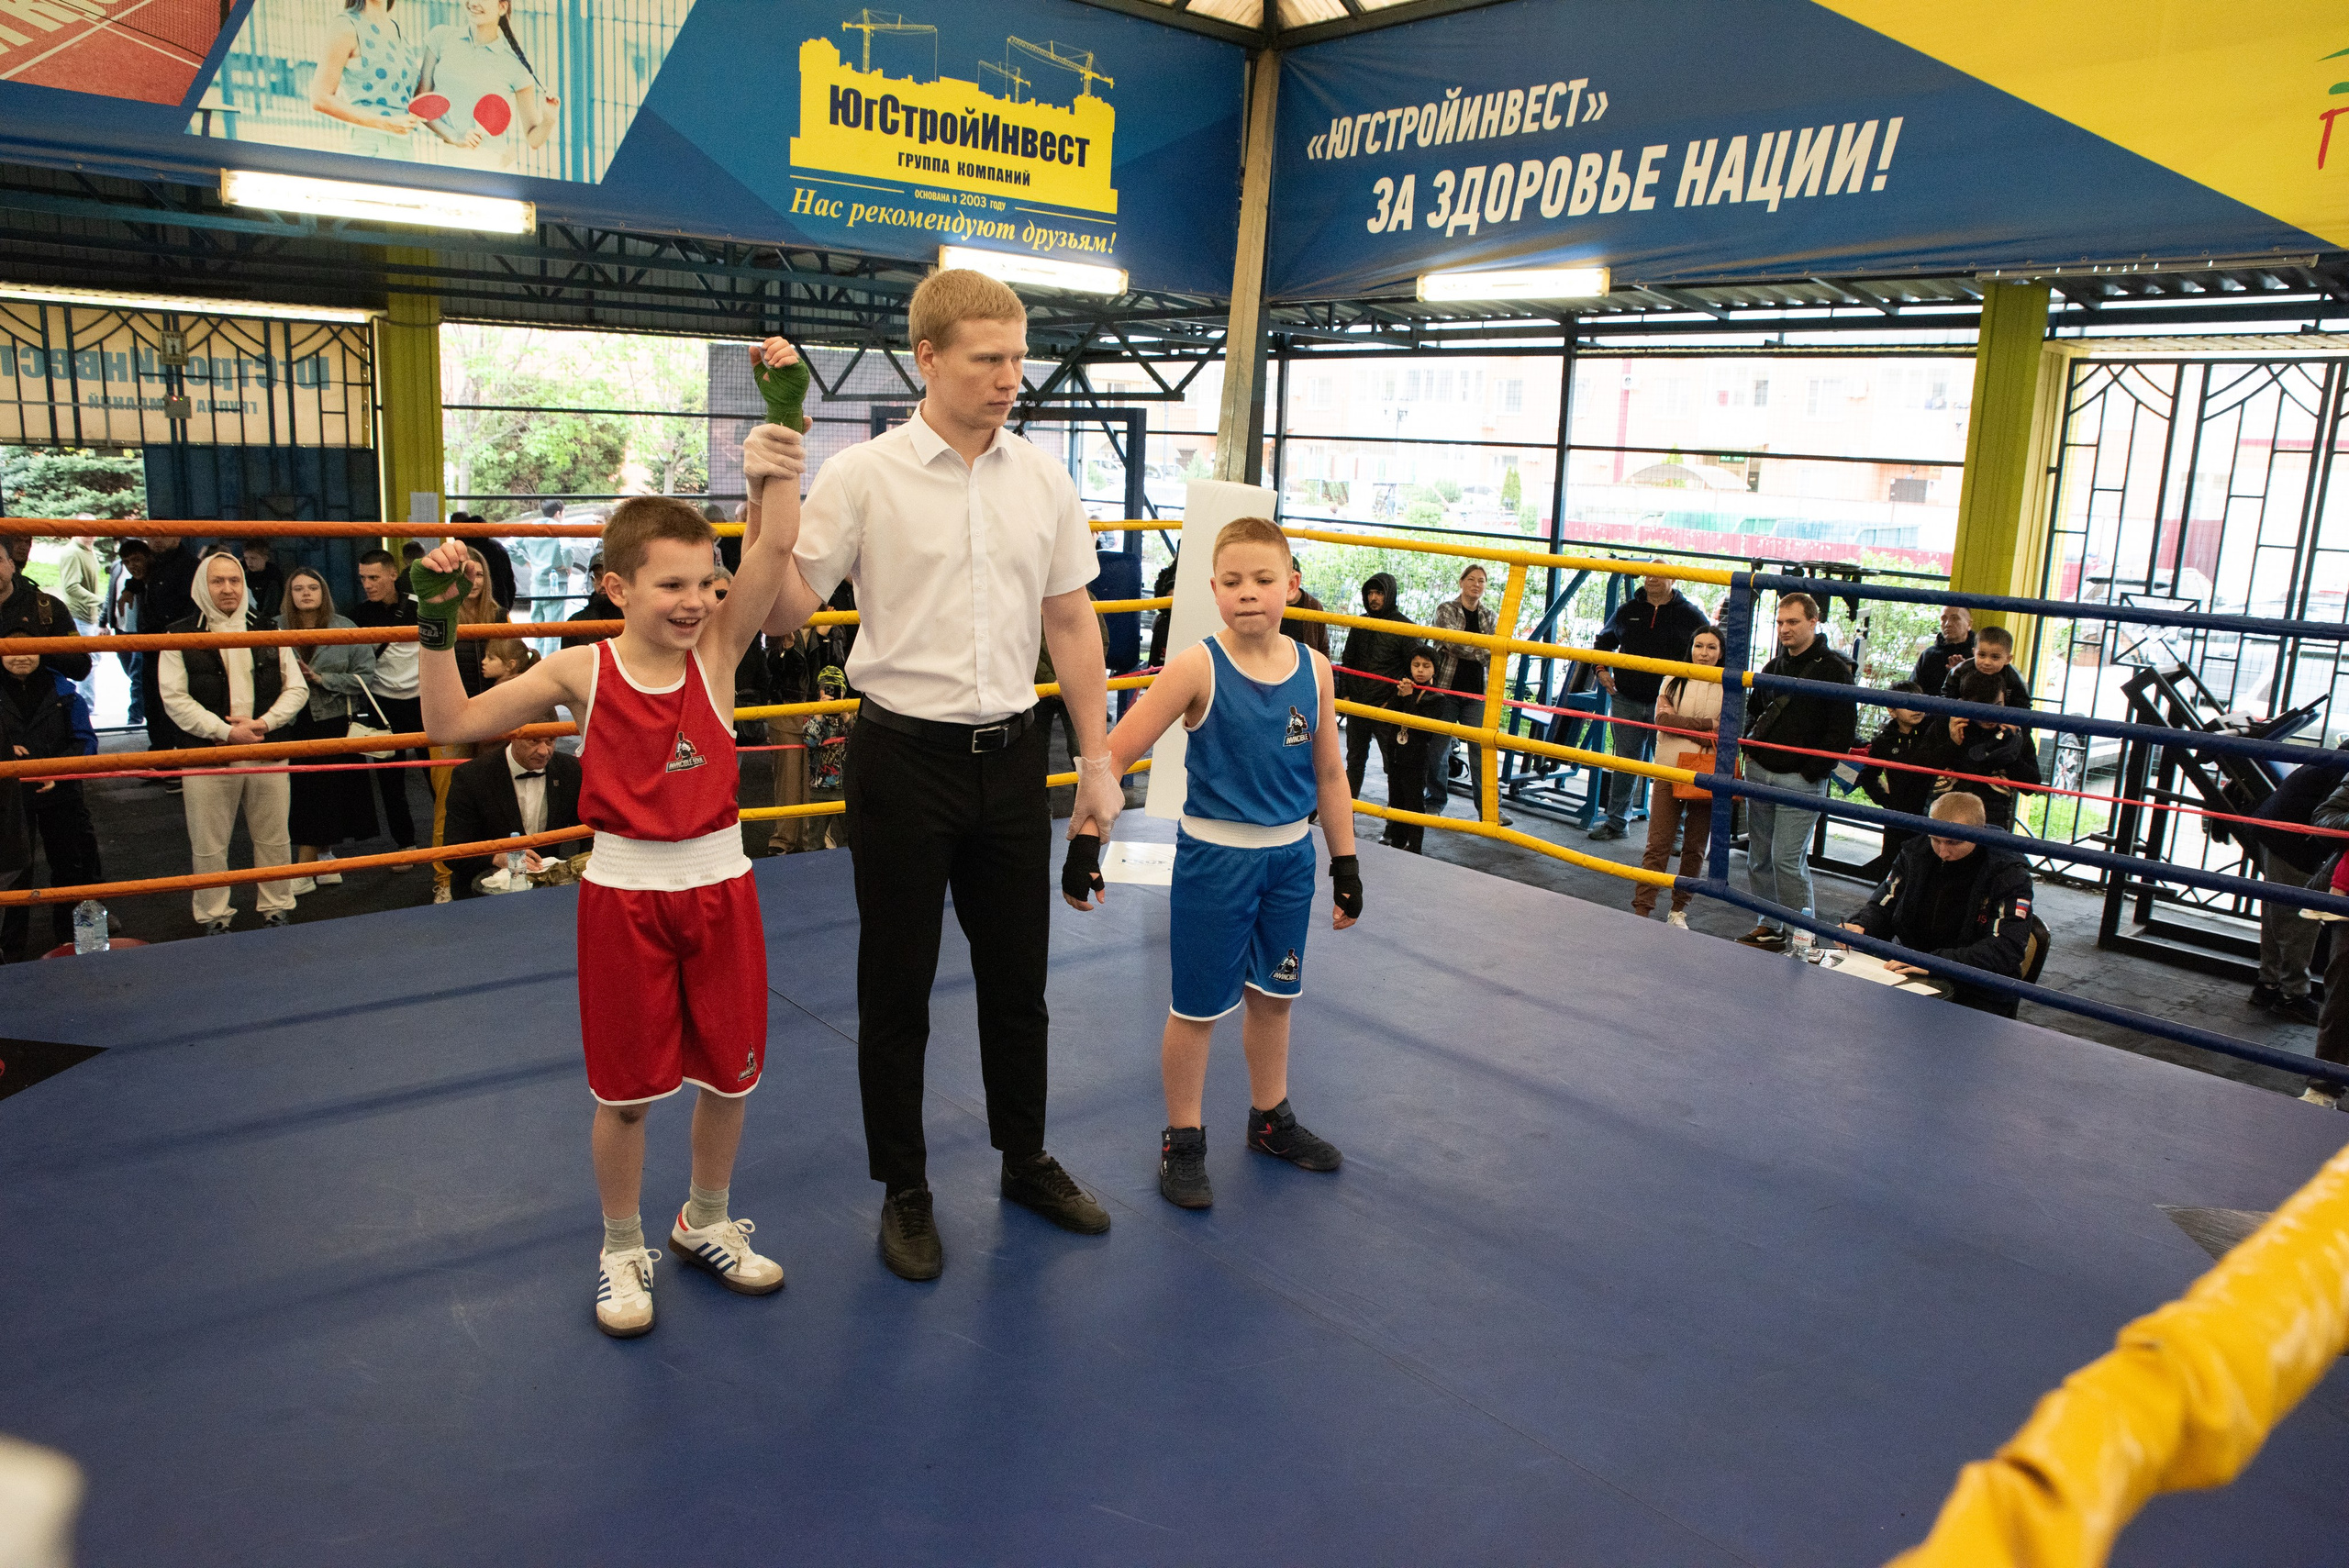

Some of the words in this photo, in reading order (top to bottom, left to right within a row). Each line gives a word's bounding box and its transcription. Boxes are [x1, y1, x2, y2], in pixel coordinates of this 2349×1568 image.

[829, 83, 1090, 168] ЮгСтройИнвест
[1307, 77, 1609, 160] «ЮГСТРОЙИНВЕСТ»
[897, 151, 950, 174] ГРУППА
[957, 161, 1030, 186] КОМПАНИЙ
[914, 189, 951, 203] ОСНОВАНА
[952, 194, 958, 204] В
[960, 193, 987, 208] 2003
[1366, 173, 1416, 234] ЗА
[1426, 144, 1669, 238] ЗДОРОВЬЕ
[1674, 117, 1904, 213] НАЦИИ!
[789, 187, 843, 218] Нас
[846, 203, 1016, 242] рекомендуют
[1022, 220, 1117, 255] друзьям!
